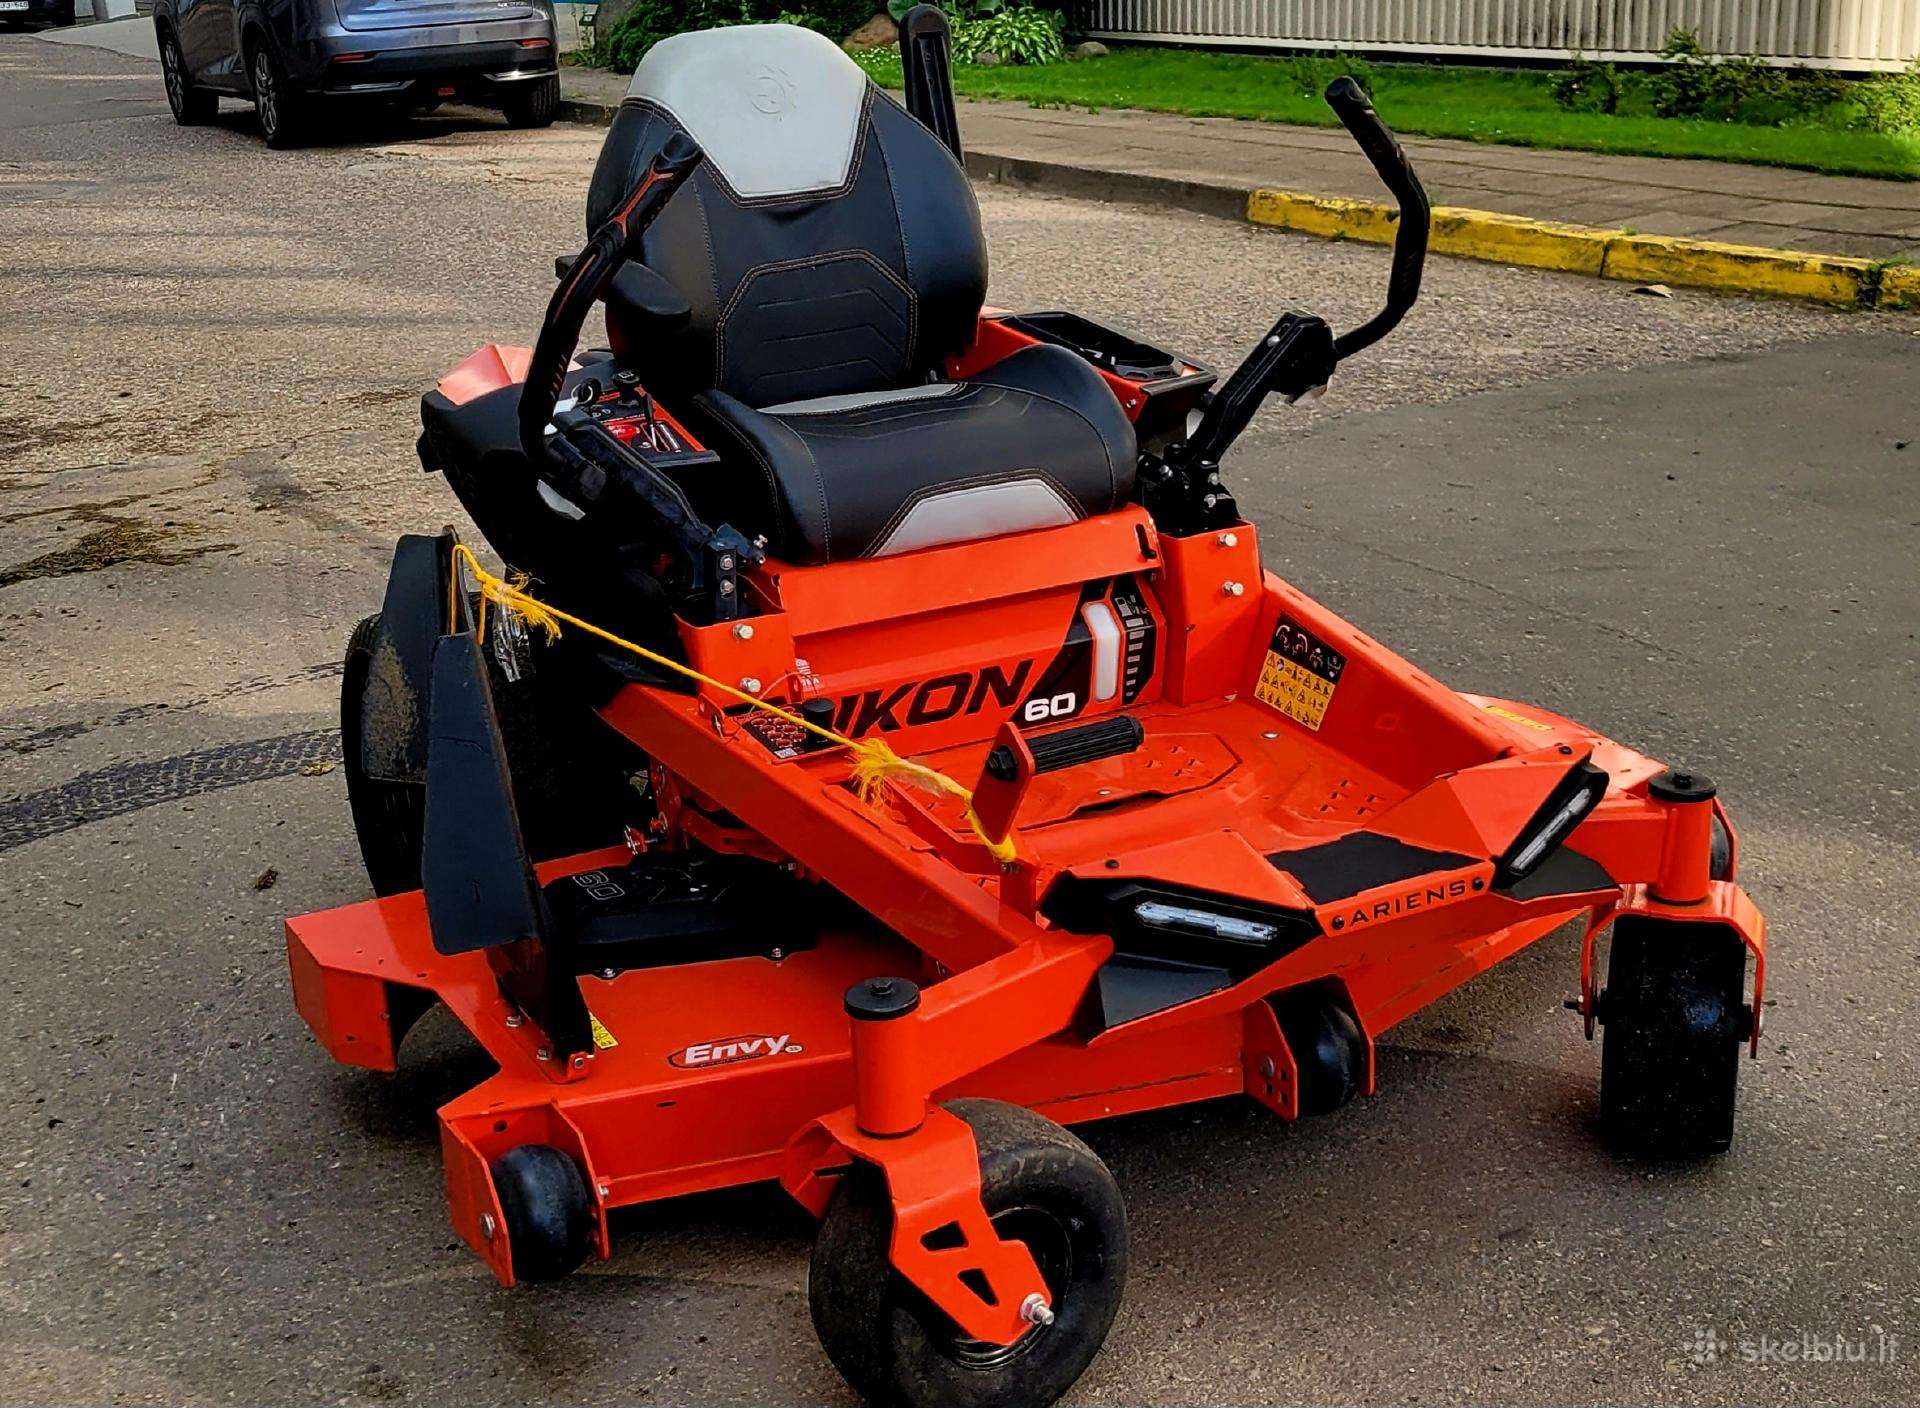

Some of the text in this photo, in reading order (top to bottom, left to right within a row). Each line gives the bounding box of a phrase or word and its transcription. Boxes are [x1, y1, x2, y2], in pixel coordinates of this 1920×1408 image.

[833, 659, 1076, 739] IKON 60
[1350, 880, 1466, 927] ARIENS
[685, 1034, 790, 1064] Envy
